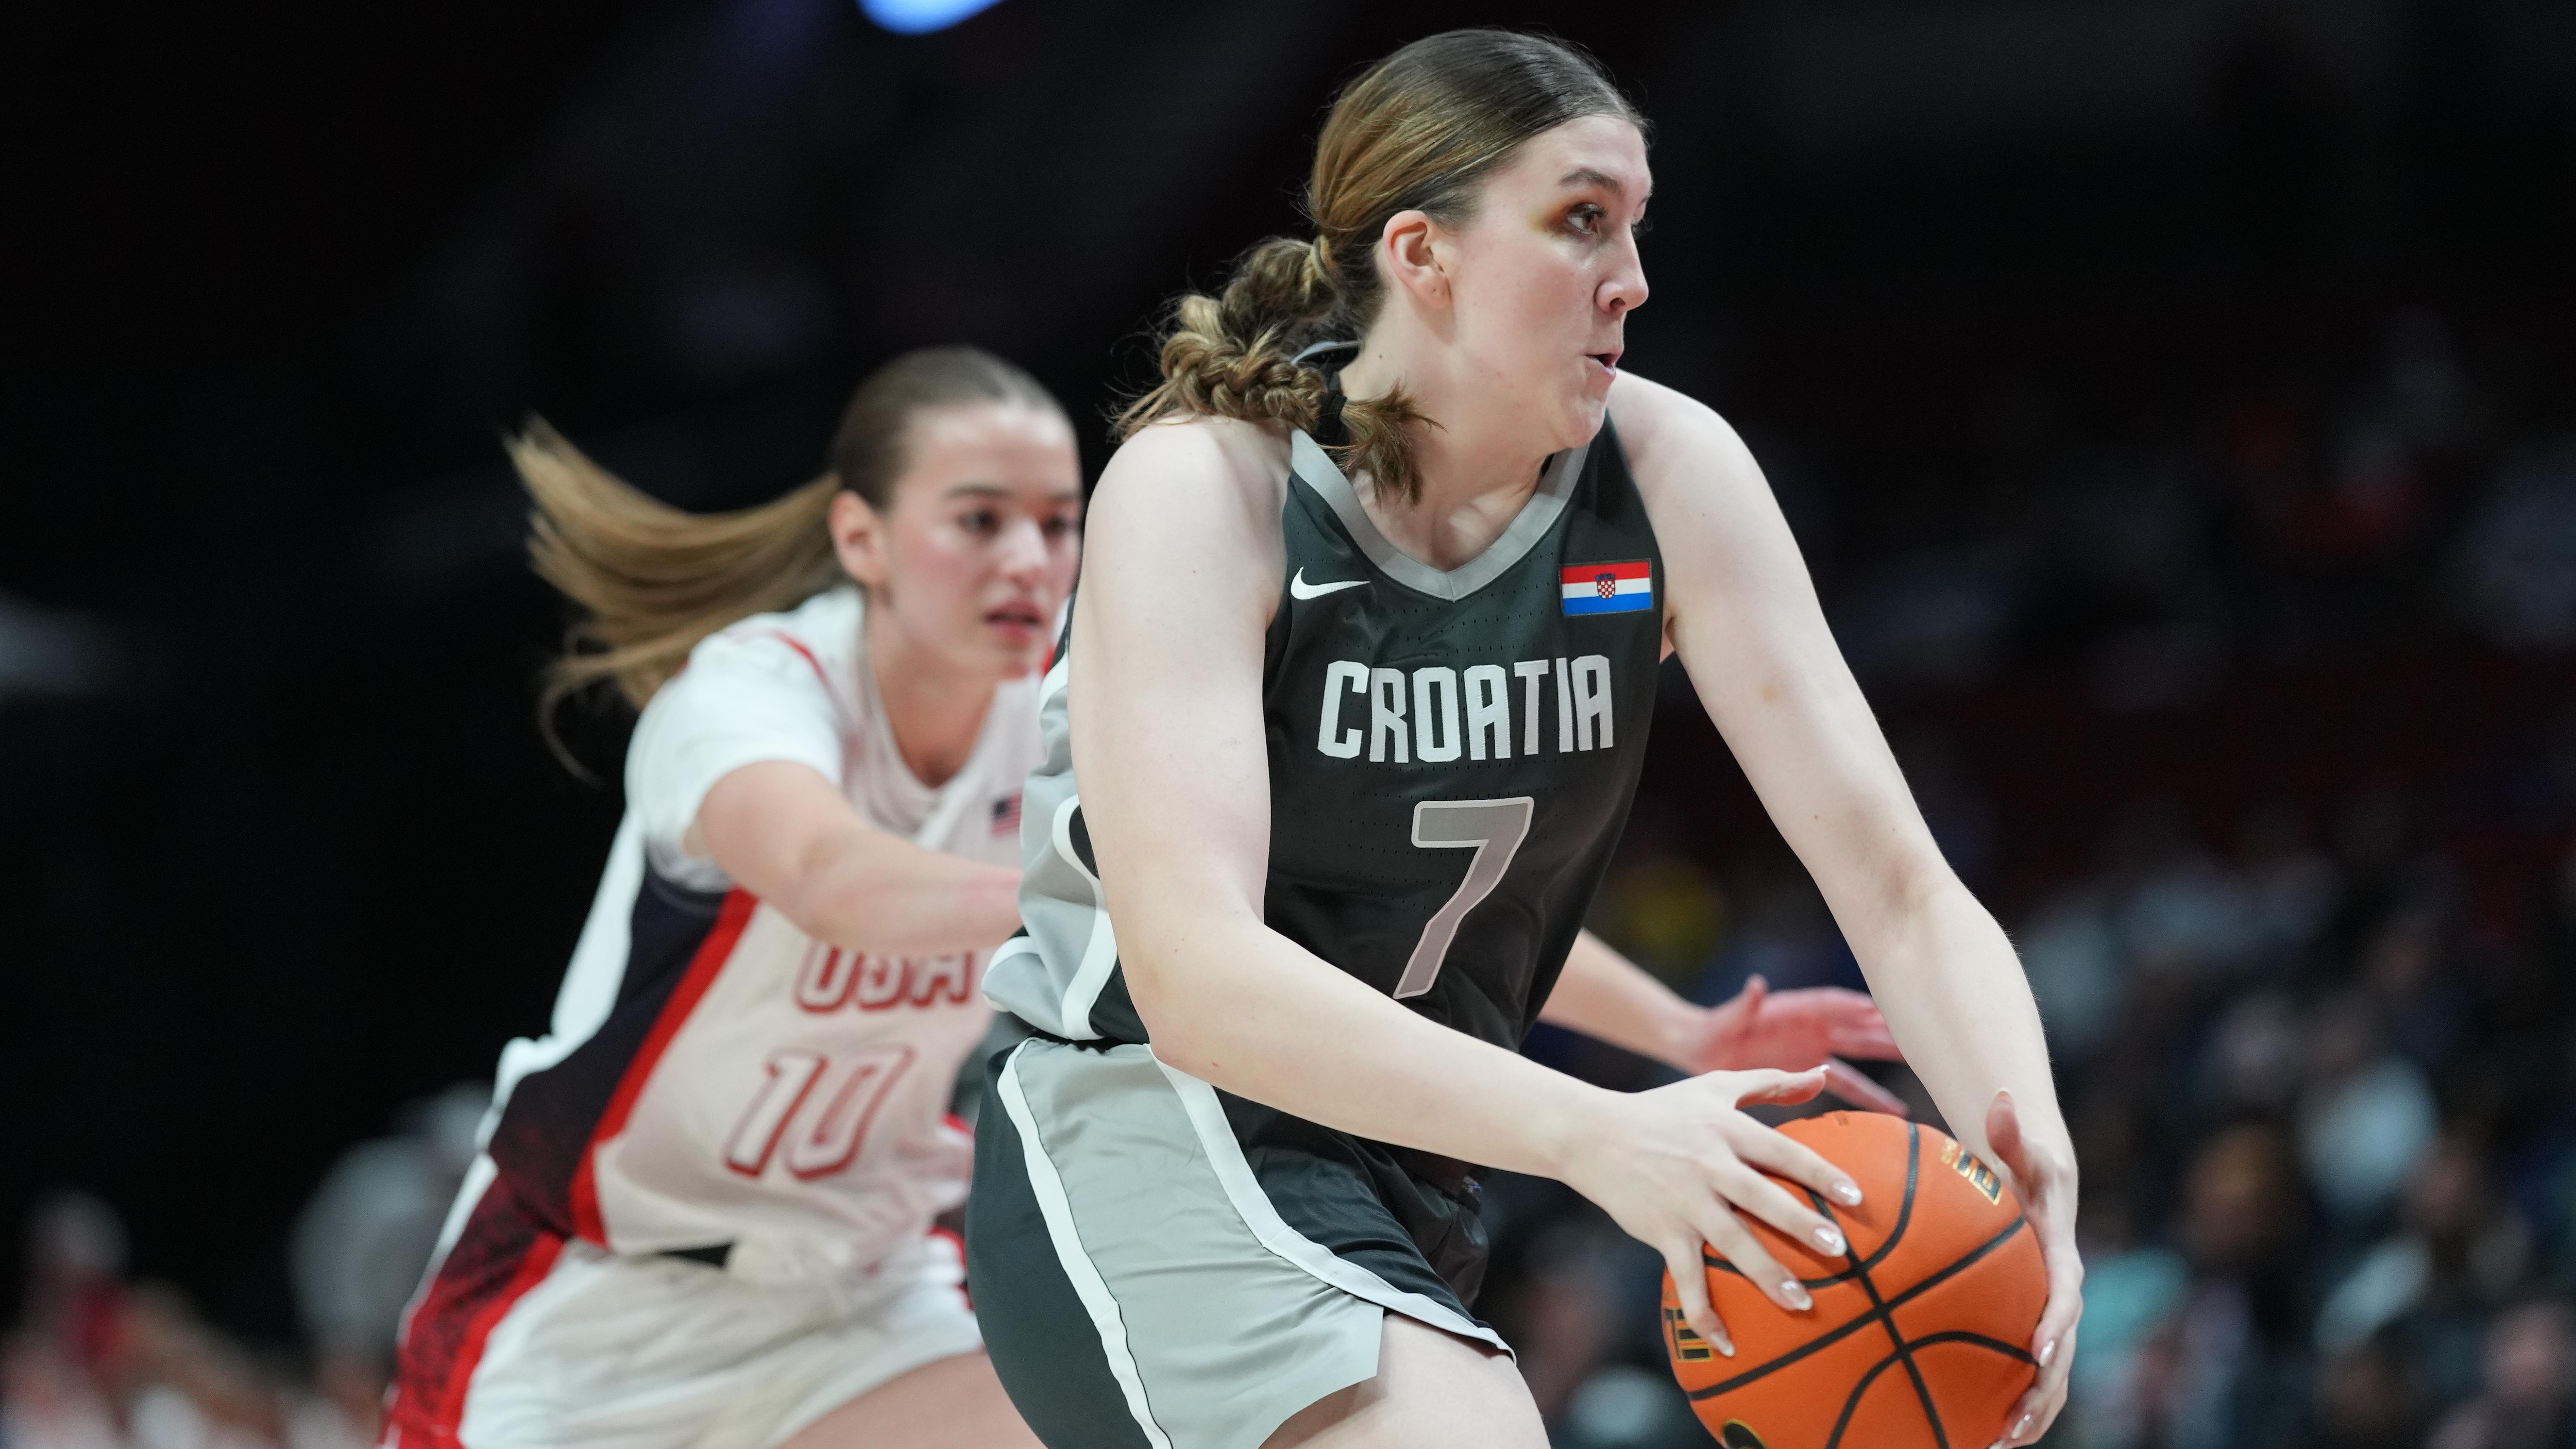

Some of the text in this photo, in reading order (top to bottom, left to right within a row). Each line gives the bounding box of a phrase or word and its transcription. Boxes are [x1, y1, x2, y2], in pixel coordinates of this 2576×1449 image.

[1317, 655, 1613, 763] CROATIA
[1393, 796, 1534, 999] 7
[723, 1045, 915, 1181] 10
